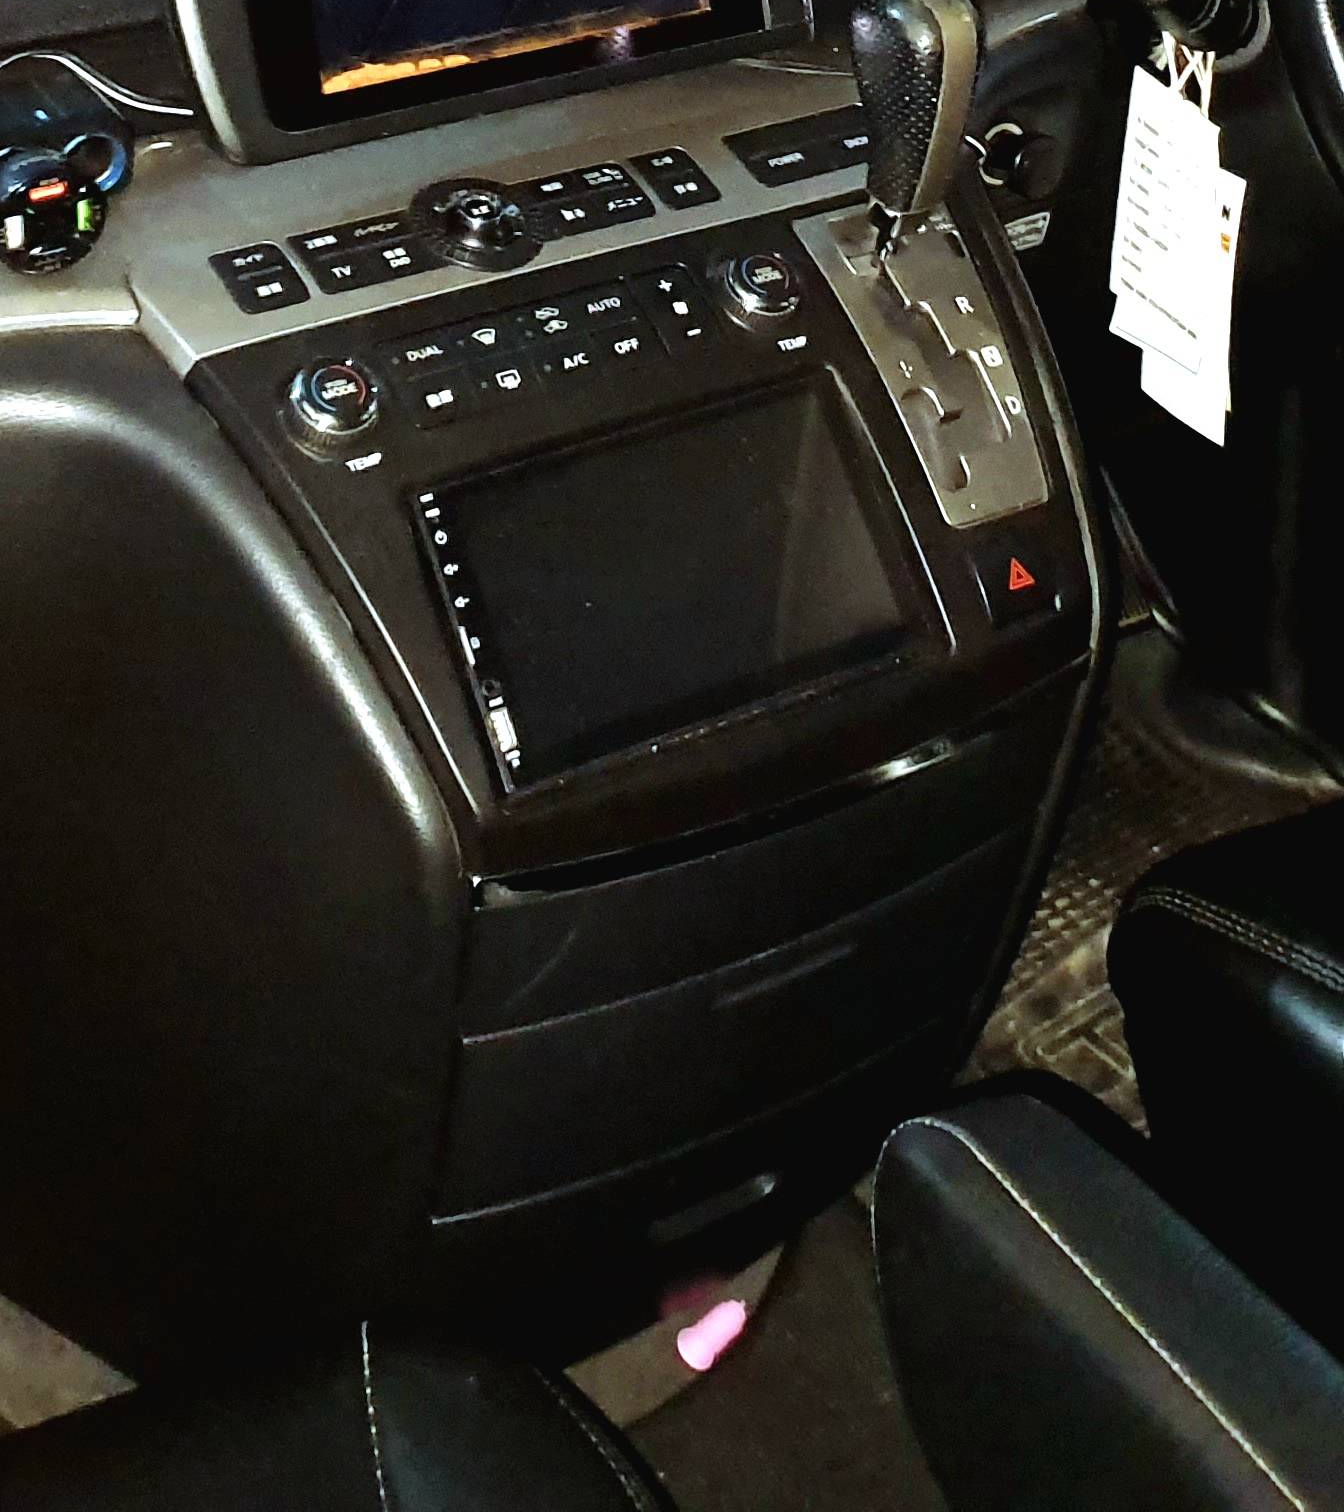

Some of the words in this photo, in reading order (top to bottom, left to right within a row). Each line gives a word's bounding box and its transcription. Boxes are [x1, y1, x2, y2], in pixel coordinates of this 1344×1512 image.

[330, 264, 353, 279] TV
[587, 297, 621, 313] AUTO
[955, 295, 974, 314] R
[406, 344, 444, 362] DUAL
[614, 338, 639, 355] OFF
[563, 352, 590, 370] A/C
[1004, 395, 1022, 415] D
